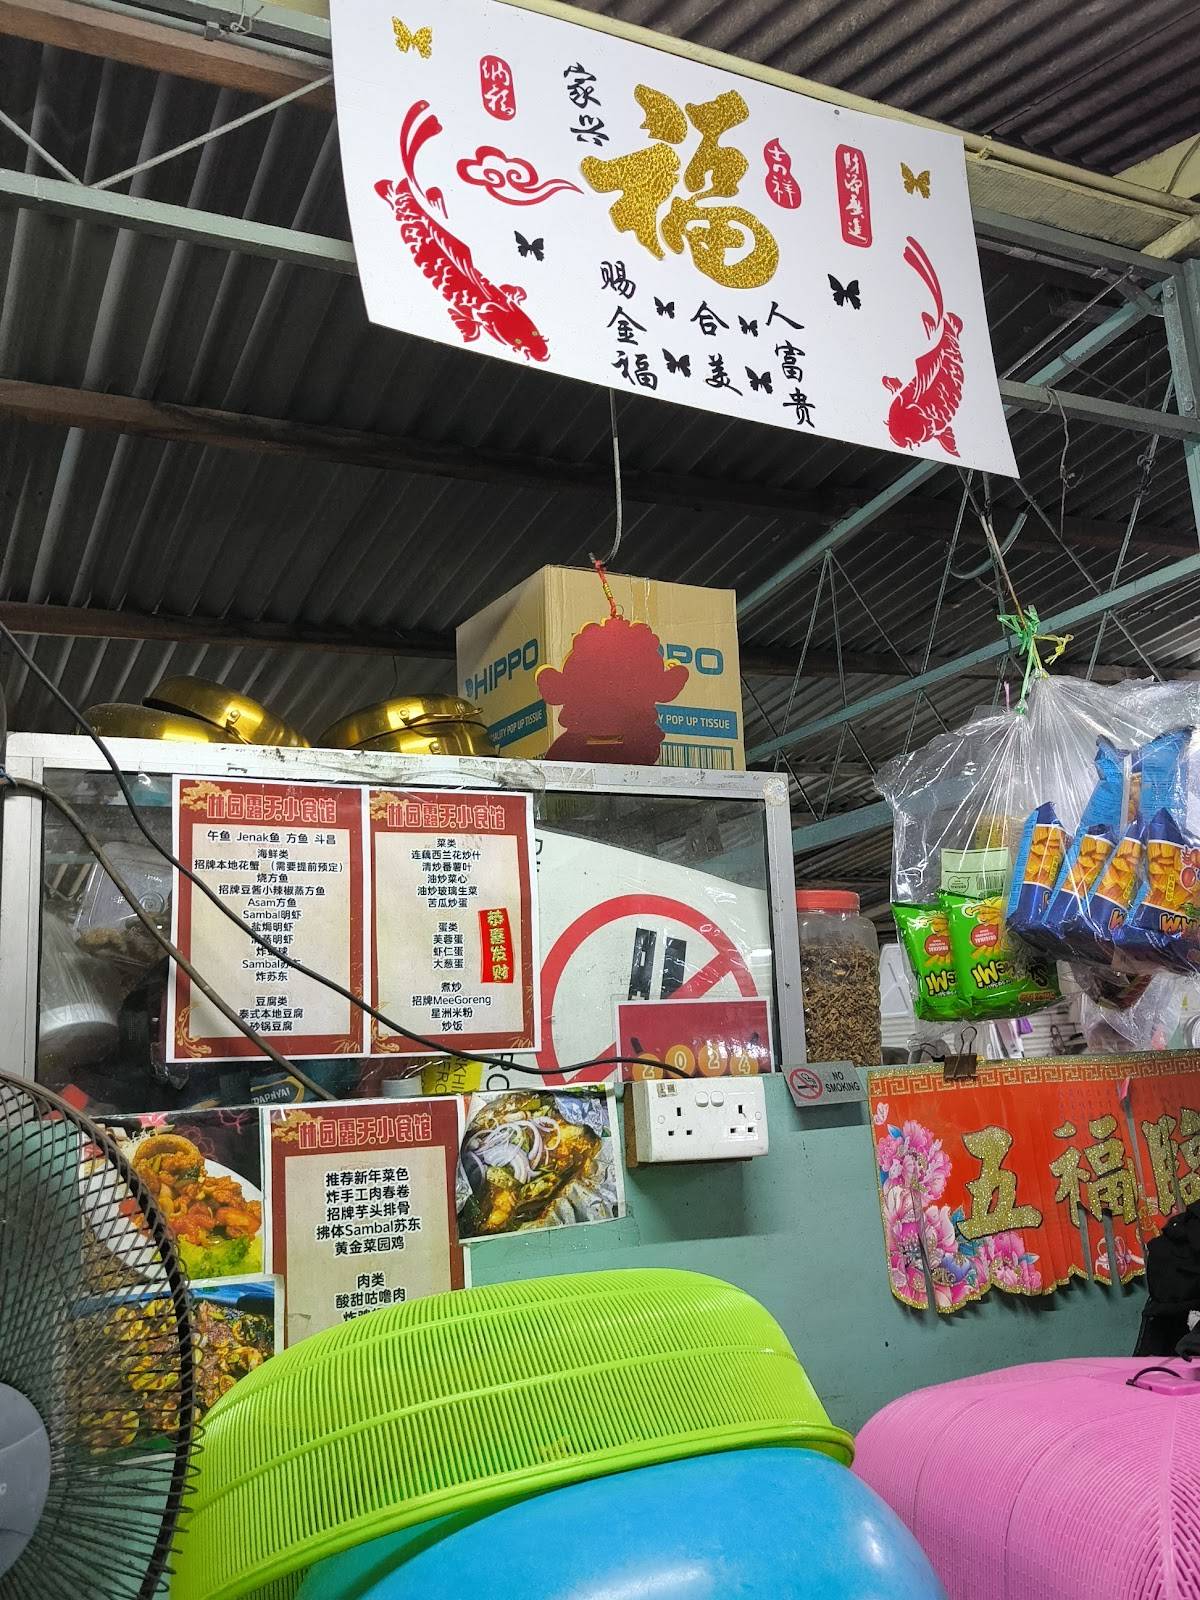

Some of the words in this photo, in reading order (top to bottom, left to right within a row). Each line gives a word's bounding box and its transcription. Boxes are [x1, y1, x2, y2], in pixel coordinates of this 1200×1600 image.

[581, 83, 780, 290] 福
[474, 638, 539, 701] HIPPO
[525, 709, 543, 726] TISSUE
[666, 714, 684, 725] POP
[686, 716, 698, 727] UP
[700, 717, 730, 730] TISSUE
[207, 829, 231, 842] 午鱼
[236, 831, 280, 843] Jenak鱼
[286, 833, 309, 845] 方鱼
[436, 838, 457, 848] 菜类
[257, 848, 289, 860] 海鲜类
[194, 859, 260, 871] 招牌本地花蟹
[422, 861, 472, 873] 清炒番薯叶
[256, 872, 289, 884] 烧方鱼
[427, 873, 468, 885] 油炒菜心
[417, 885, 478, 897] 油炒玻璃生菜
[247, 897, 297, 909] Asam方鱼
[428, 897, 468, 909] 苦瓜炒蛋
[243, 909, 303, 920] Sambal明虾
[438, 922, 458, 933] 蛋类
[433, 934, 464, 945] 芙蓉蛋
[433, 946, 464, 957] 虾仁蛋
[433, 958, 464, 969] 大葱蛋
[255, 971, 289, 982] 炸苏东
[440, 981, 462, 993] 煮炒
[255, 996, 289, 1007] 豆腐类
[412, 995, 492, 1007] 招牌MeeGoreng
[239, 1008, 304, 1020] 泰式本地豆腐
[431, 1007, 473, 1019] 星洲米粉
[249, 1021, 294, 1032] 砂锅豆腐
[441, 1020, 463, 1032] 炒饭
[831, 1071, 845, 1081] NO
[825, 1081, 861, 1093] SMOKING
[325, 1167, 409, 1187] 推荐新年菜色
[326, 1185, 410, 1204] 炸手工肉春卷
[326, 1202, 411, 1222] 招牌芋头排骨
[335, 1236, 405, 1256] 黄金菜园鸡
[357, 1272, 385, 1289] 肉类
[335, 1287, 406, 1309] 酸甜咕噜肉
